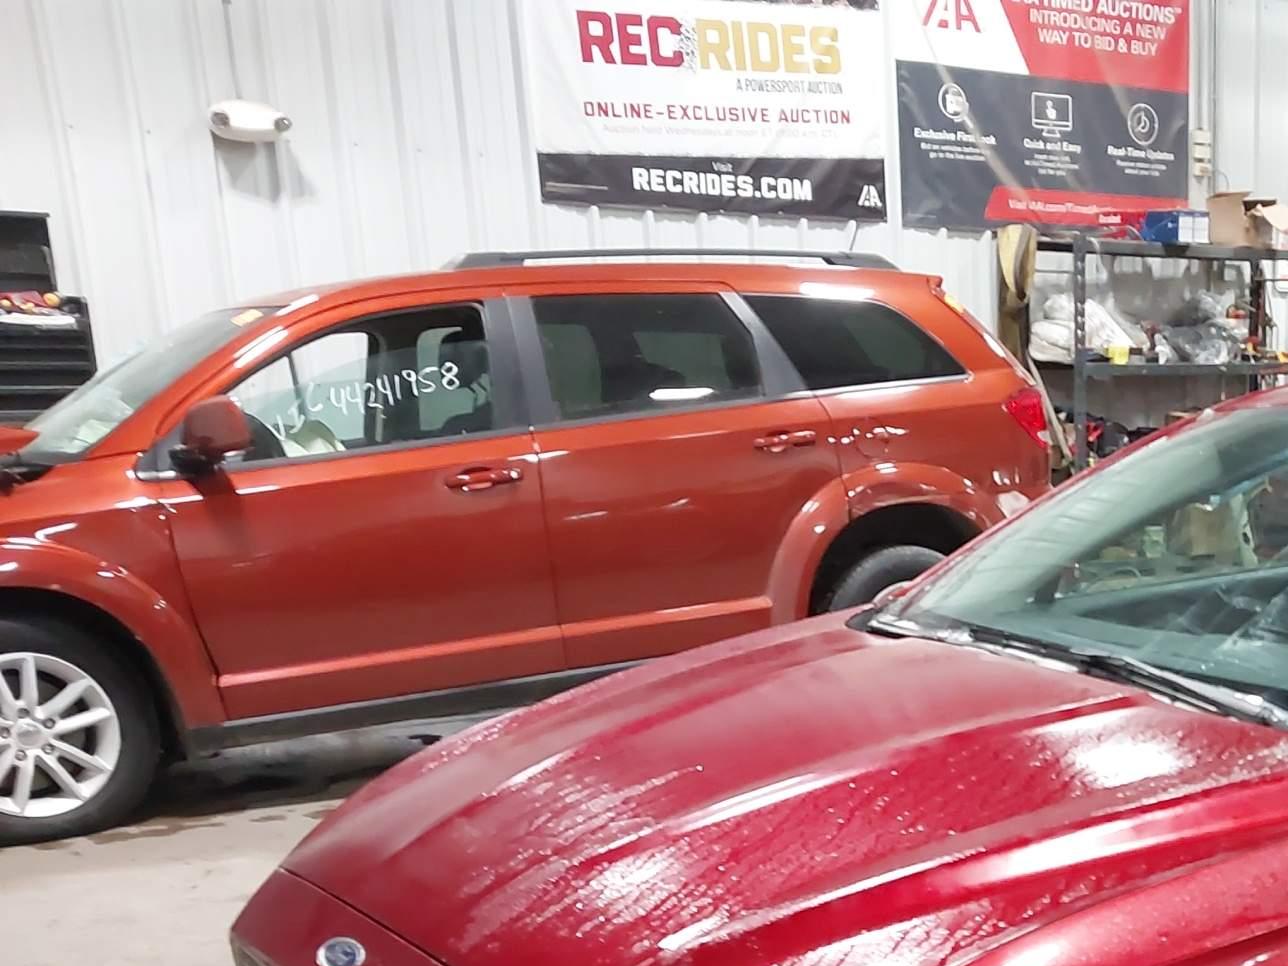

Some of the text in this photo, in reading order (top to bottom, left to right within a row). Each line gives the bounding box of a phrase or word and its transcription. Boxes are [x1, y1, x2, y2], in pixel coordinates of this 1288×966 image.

[1029, 9, 1167, 41] INTRODUCING A NEW
[576, 10, 843, 75] REC RIDES
[1038, 28, 1159, 57] WAY TO BID & BUY
[736, 78, 844, 95] A POWERSPORT AUCTION
[583, 101, 852, 124] ONLINE-EXCLUSIVE AUCTION
[632, 167, 813, 201] RECRIDES.COM
